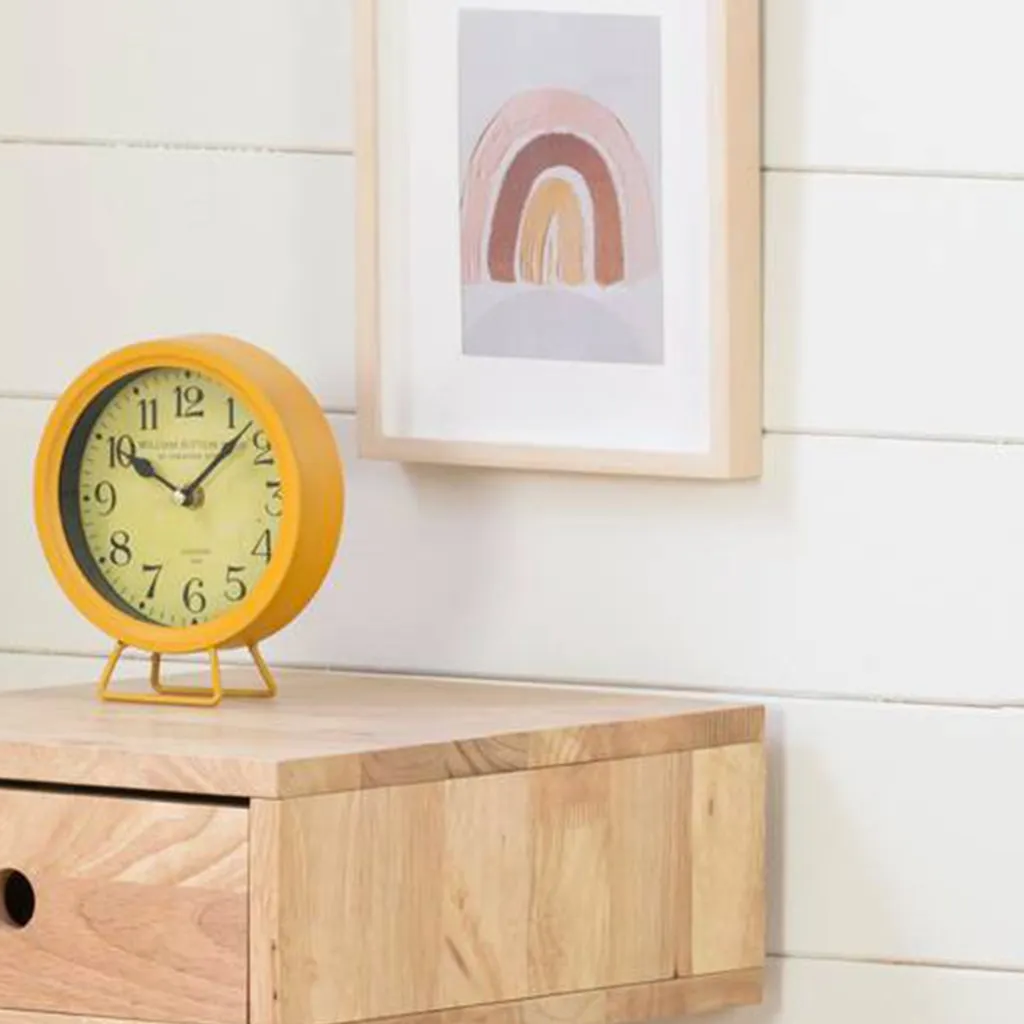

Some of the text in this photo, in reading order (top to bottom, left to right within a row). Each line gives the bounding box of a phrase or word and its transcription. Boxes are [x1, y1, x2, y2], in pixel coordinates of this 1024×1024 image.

[138, 398, 158, 430] 11
[174, 386, 205, 418] 12
[226, 397, 236, 429] 1
[107, 434, 136, 468] 10
[252, 430, 275, 465] 2
[94, 480, 117, 516] 9
[264, 481, 283, 517] 3
[109, 530, 132, 566] 8
[251, 528, 272, 564] 4
[142, 564, 163, 599] 7
[182, 577, 207, 614] 6
[224, 566, 247, 601] 5
